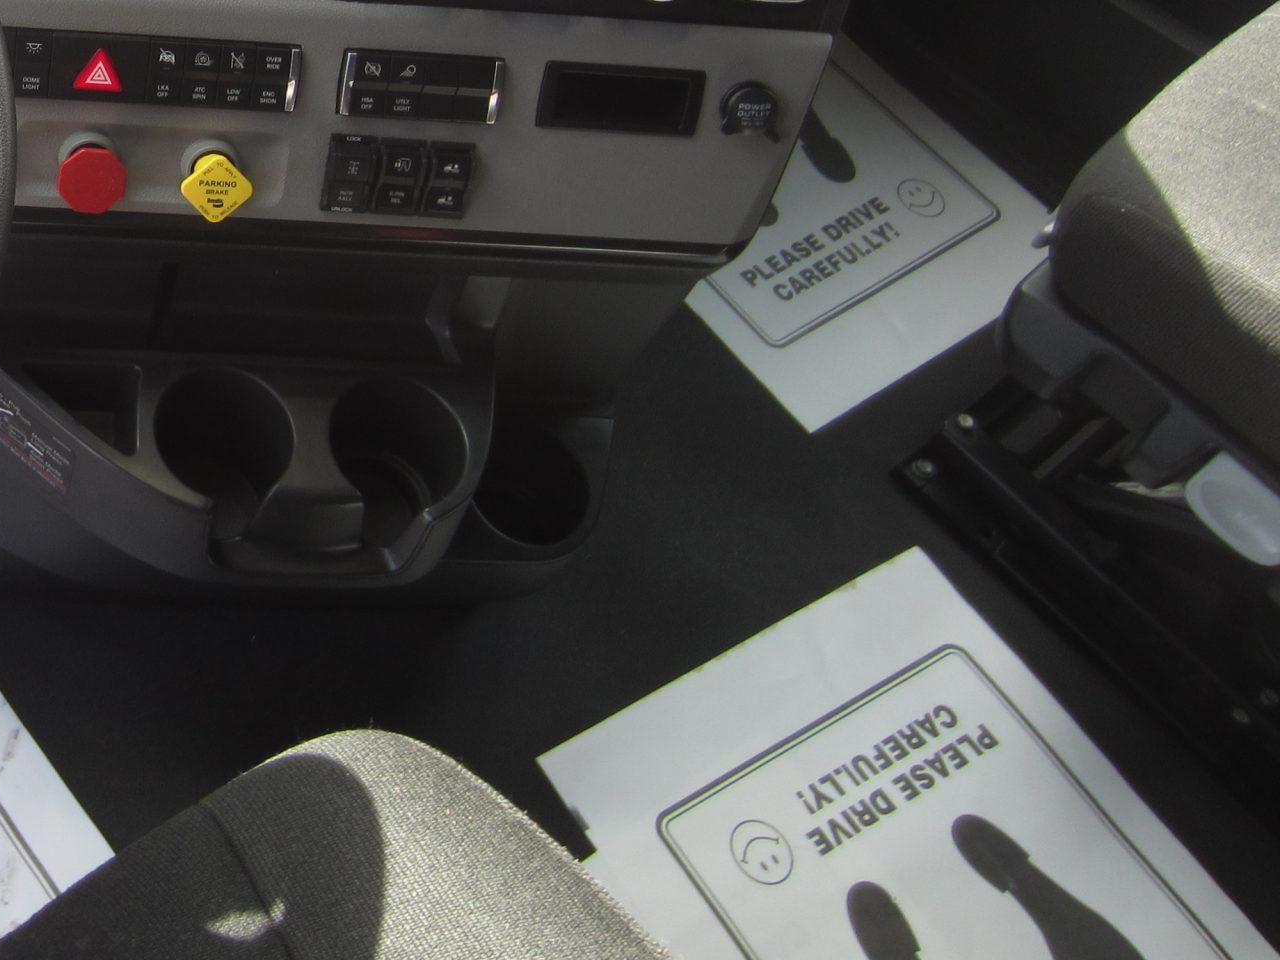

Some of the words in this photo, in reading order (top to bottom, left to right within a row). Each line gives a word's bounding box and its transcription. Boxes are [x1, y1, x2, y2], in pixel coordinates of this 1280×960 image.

[266, 56, 282, 64] OVER
[262, 90, 275, 98] ENG
[393, 105, 411, 113] LIGHT
[738, 103, 772, 111] POWER
[737, 110, 771, 118] OUTLET
[199, 179, 237, 188] PARKING
[740, 232, 826, 289] PLEASE
[820, 196, 890, 256] DRIVE
[772, 221, 901, 302] CAREFULLY!
[795, 704, 958, 815] CAREFULLY!
[891, 723, 999, 801] PLEASE
[805, 787, 897, 856] DRIVE
